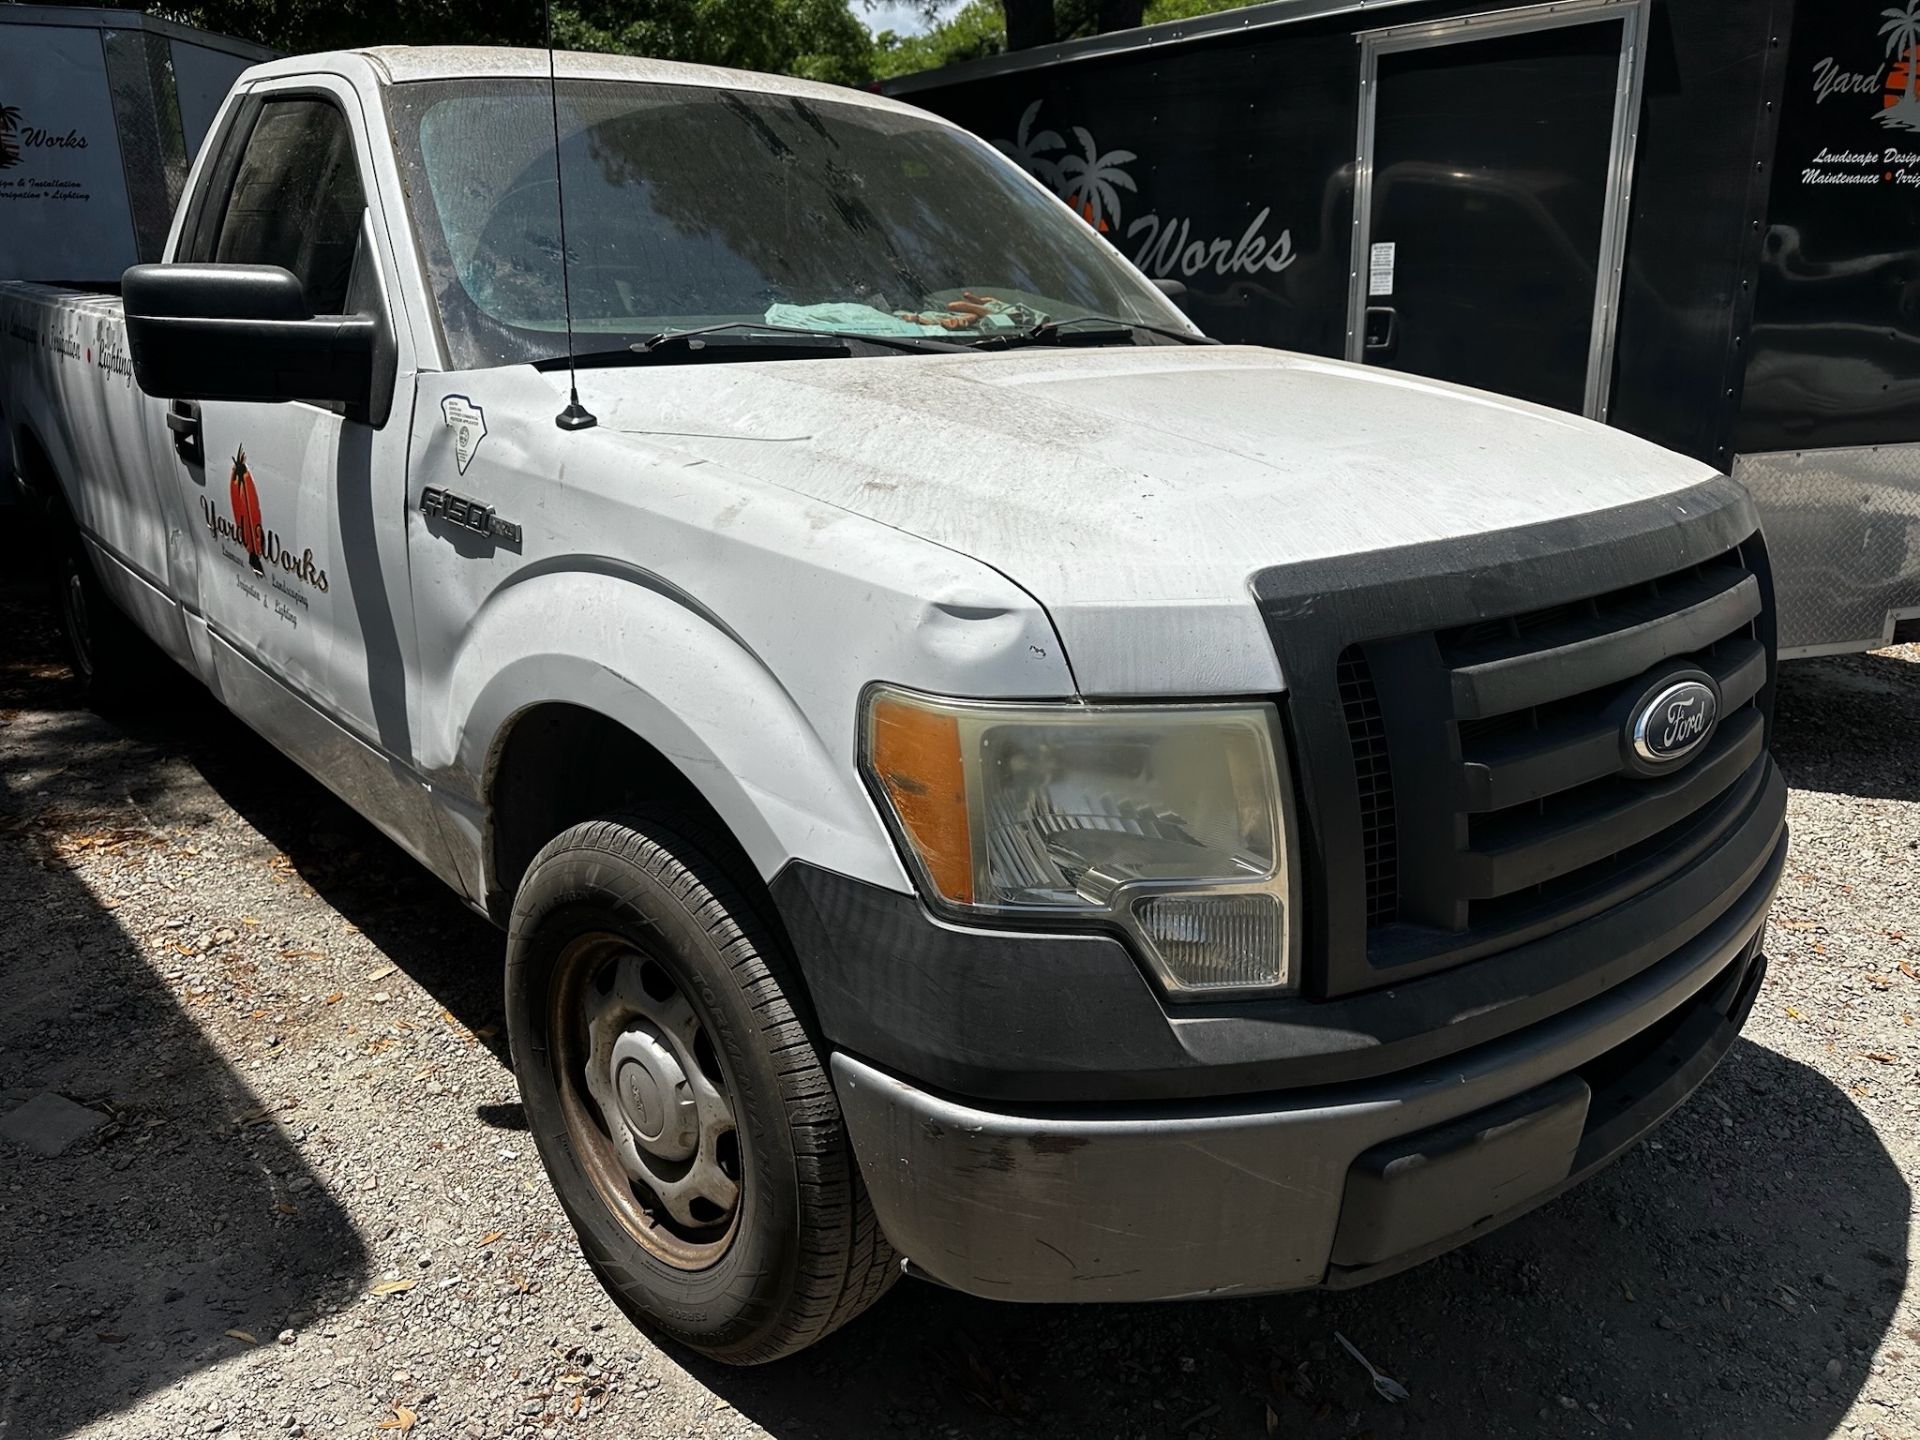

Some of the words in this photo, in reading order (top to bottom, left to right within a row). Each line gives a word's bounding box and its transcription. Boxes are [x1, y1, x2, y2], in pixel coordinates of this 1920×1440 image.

[1812, 56, 1886, 105] Yard
[20, 126, 89, 149] Works
[1812, 147, 1879, 166] Landscape
[28, 178, 82, 188] Installation
[1801, 167, 1880, 185] Maintenance
[0, 190, 40, 200] rrigation
[51, 189, 90, 202] Lighting
[1126, 206, 1297, 278] Works
[98, 338, 132, 388] Lighting
[200, 494, 250, 549] Yard
[255, 523, 329, 593] Works
[1664, 696, 1705, 747] Ford
